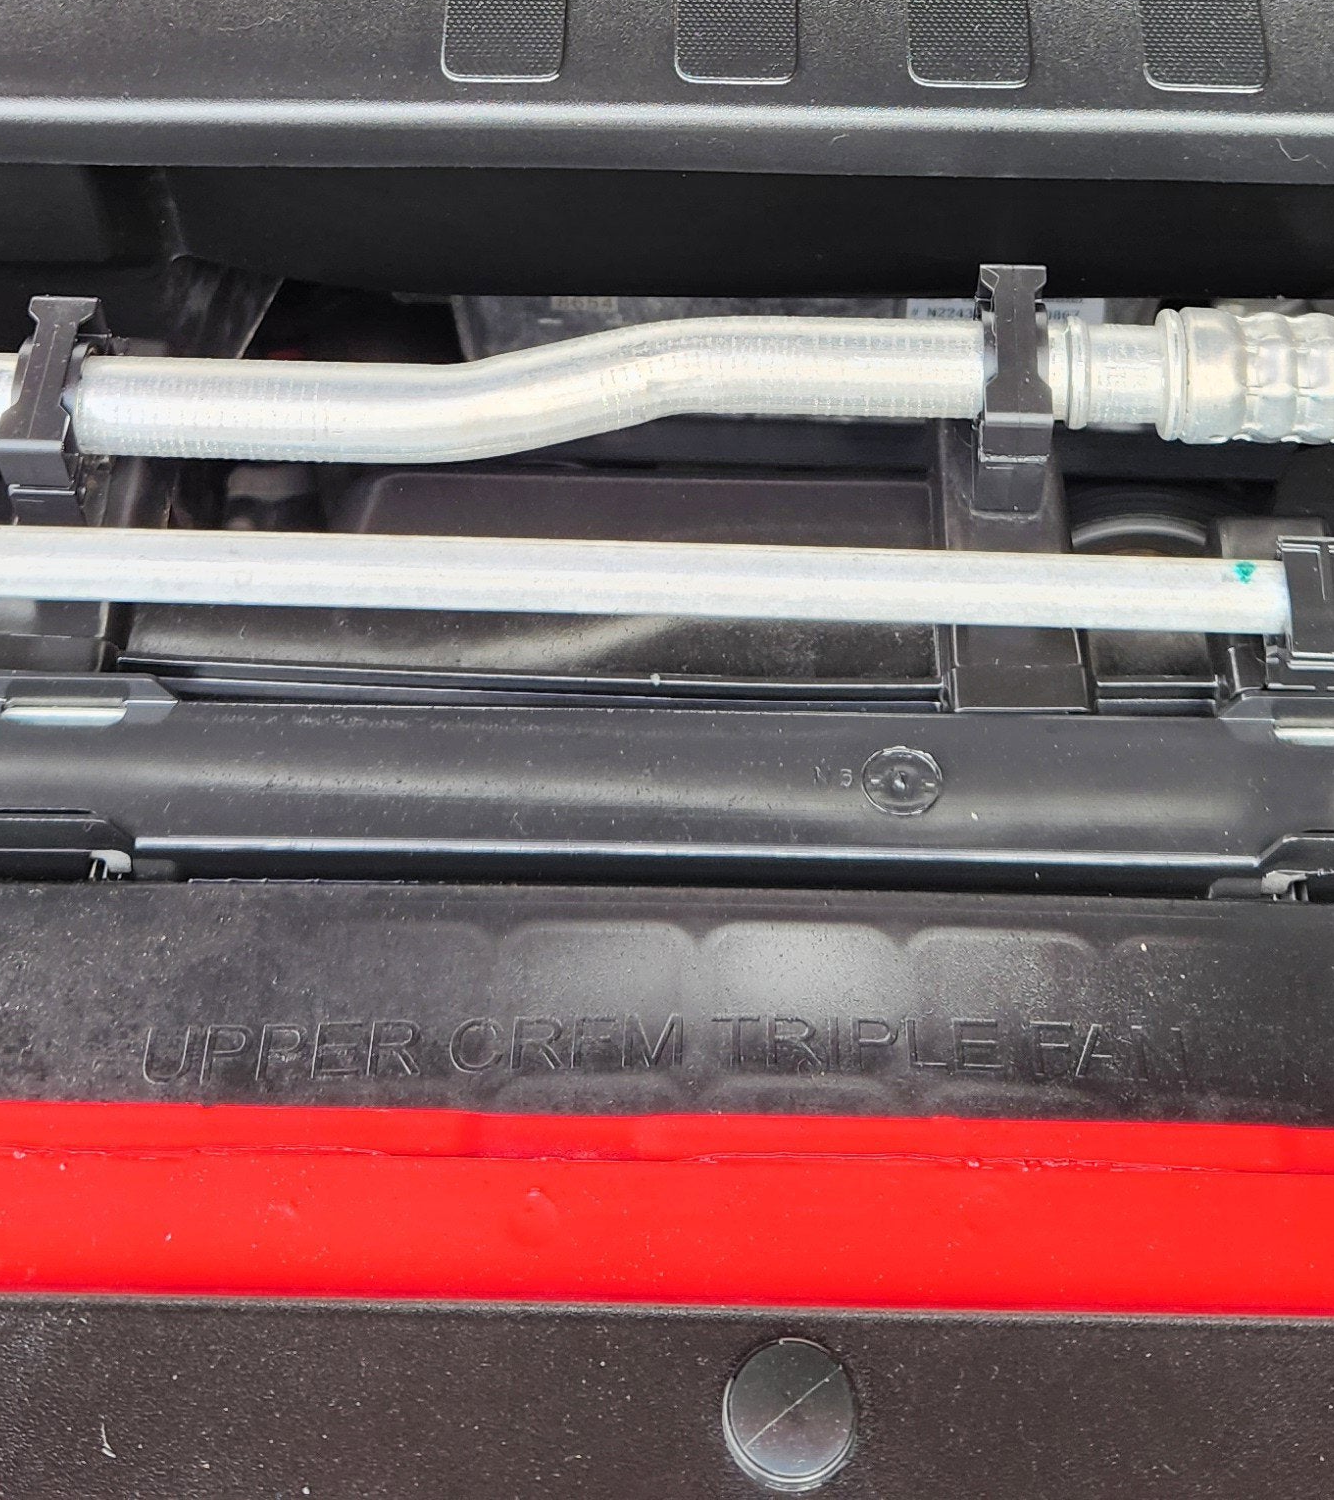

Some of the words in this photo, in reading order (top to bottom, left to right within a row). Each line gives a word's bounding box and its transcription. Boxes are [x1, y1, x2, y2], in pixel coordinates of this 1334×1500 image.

[139, 1019, 424, 1088] UPPER
[710, 1012, 1003, 1073] TRIPLE
[1029, 1019, 1189, 1084] FAN
